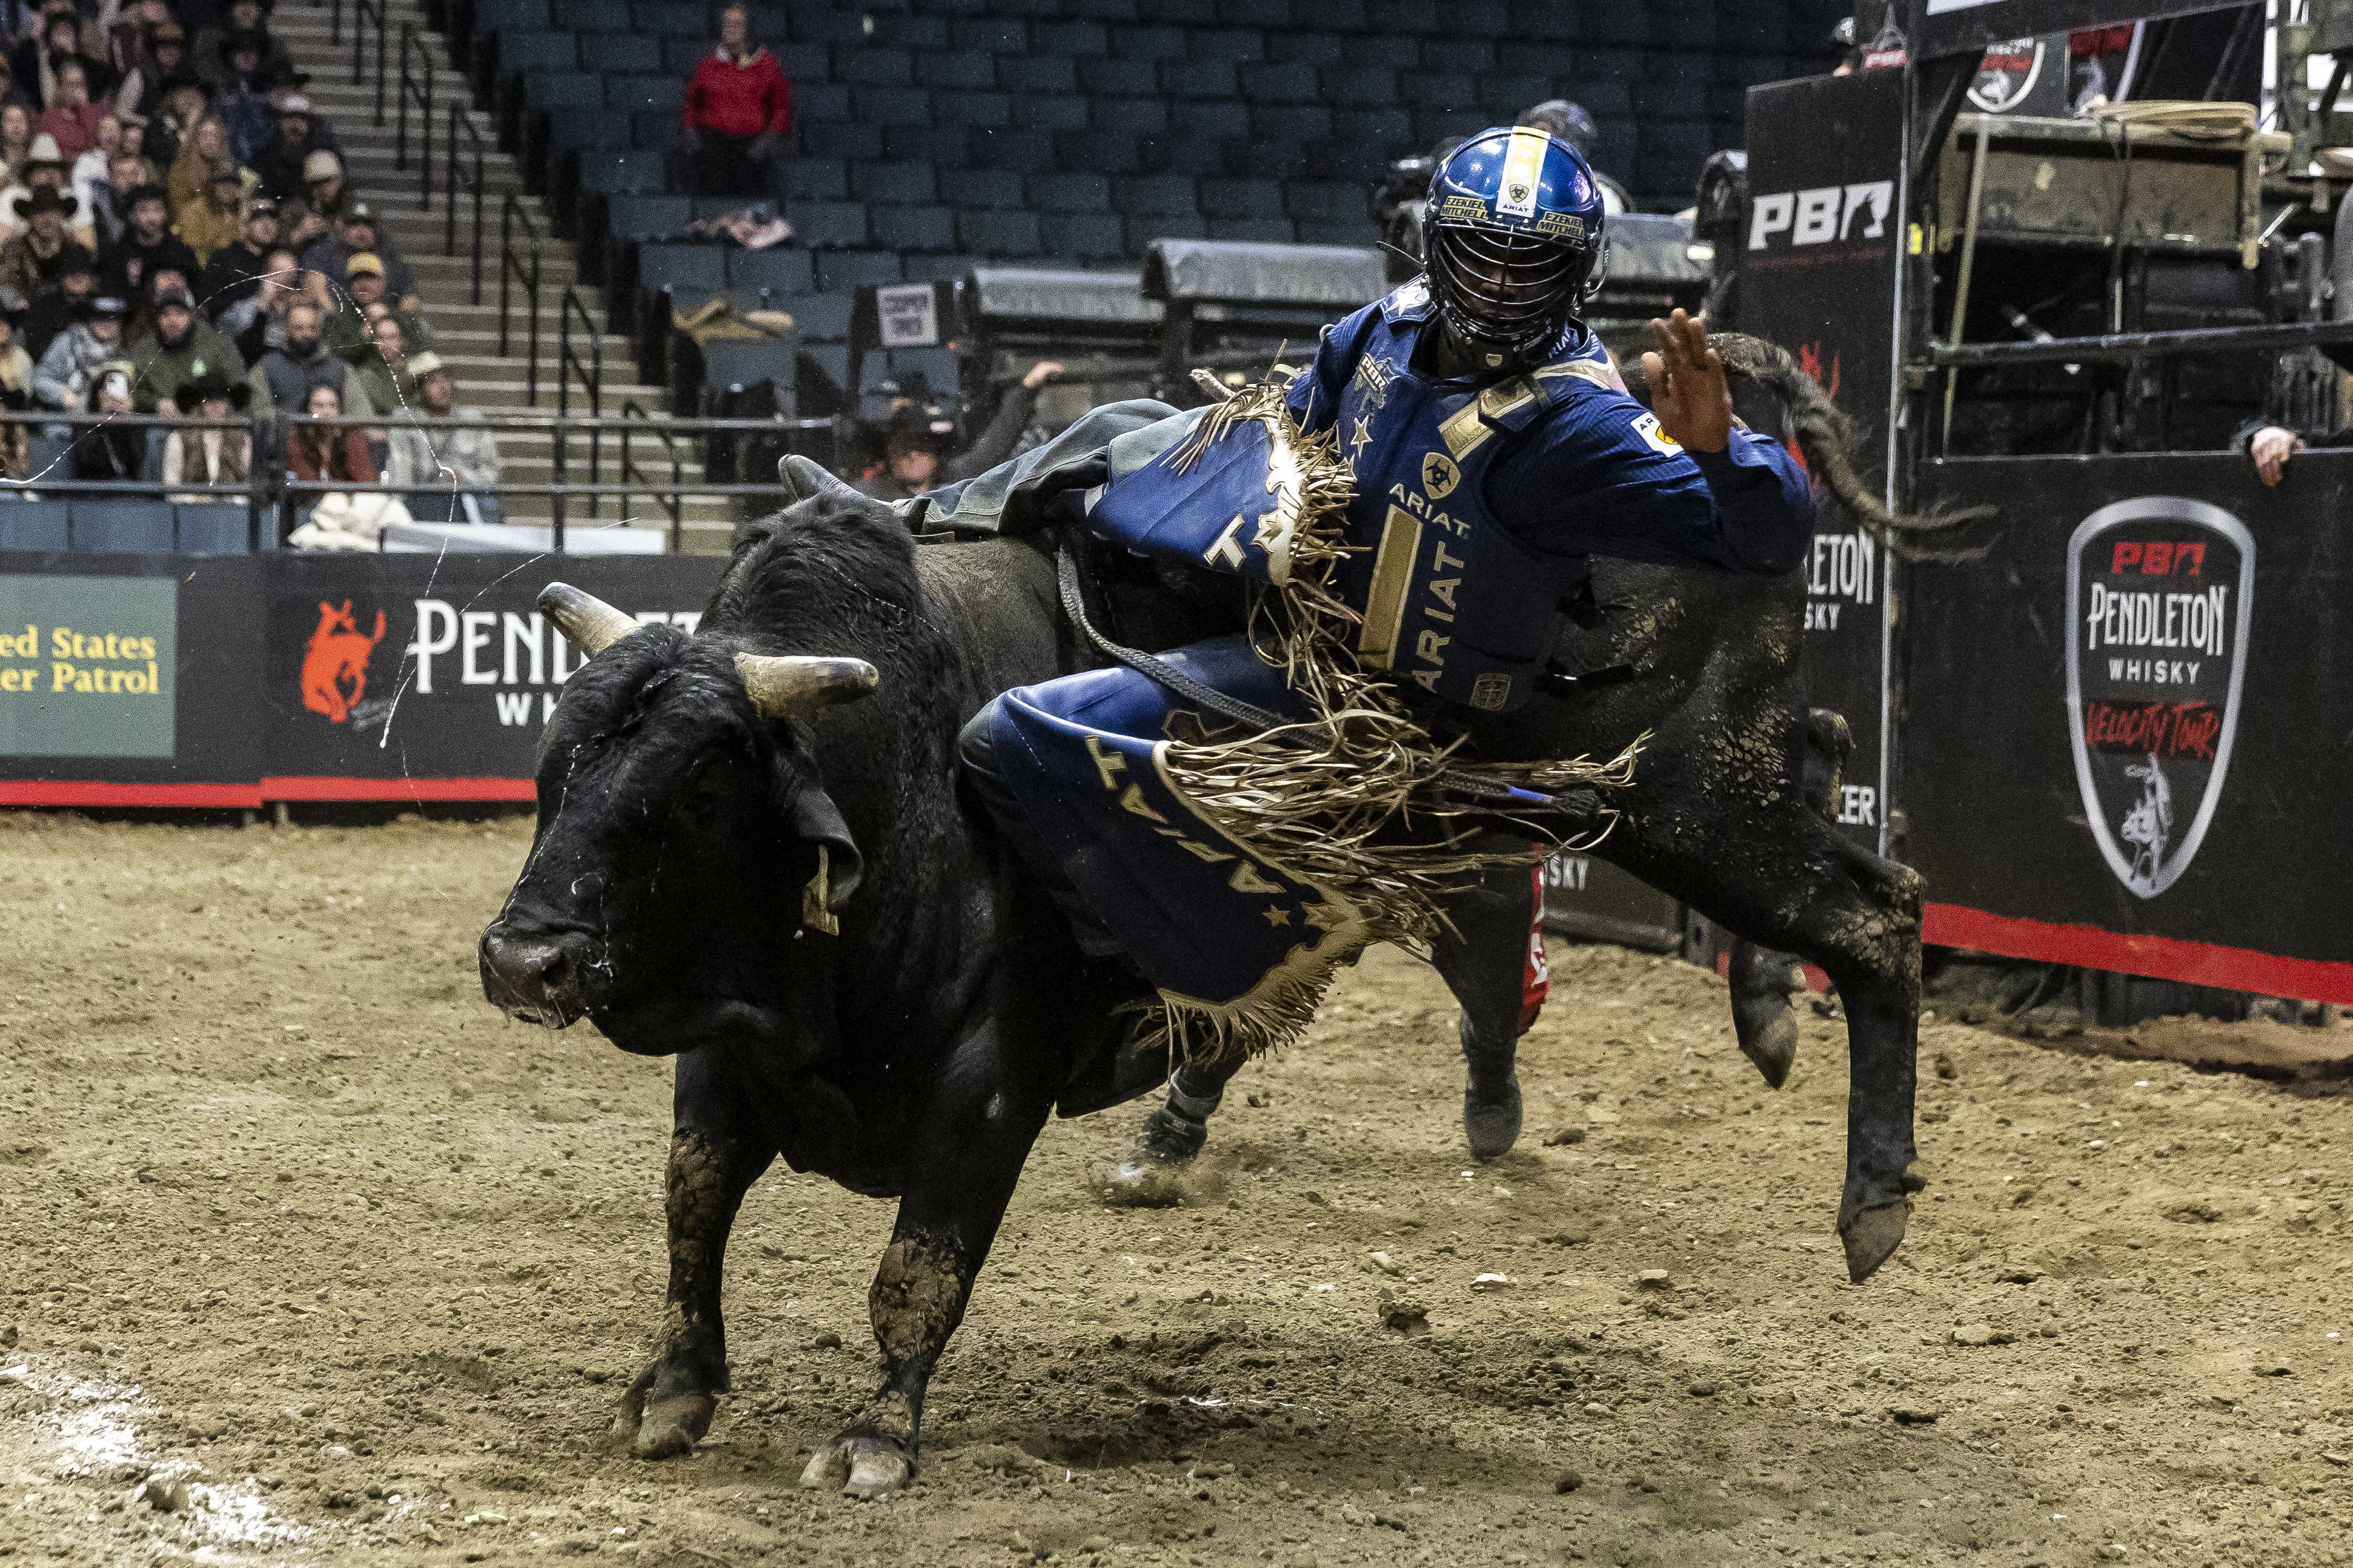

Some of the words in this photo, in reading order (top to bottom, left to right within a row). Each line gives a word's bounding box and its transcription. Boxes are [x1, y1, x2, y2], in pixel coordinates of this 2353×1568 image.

[1440, 207, 1488, 220] MITCHELL
[1445, 197, 1485, 211] EZEKIEL
[1502, 203, 1530, 213] ARIAT
[1544, 212, 1583, 228] EZEKIEL
[1748, 180, 1894, 251] PBR
[1361, 354, 1388, 389] PBR
[1389, 482, 1471, 536] ARIAT
[1203, 512, 1247, 571] T
[2111, 541, 2206, 575] PBR
[1411, 540, 1465, 694] ARIAT
[2086, 582, 2228, 657] PENDLETON
[51, 627, 156, 660] States
[0, 668, 39, 692] er
[51, 660, 159, 694] Patrol
[2109, 658, 2200, 684] WHISKY
